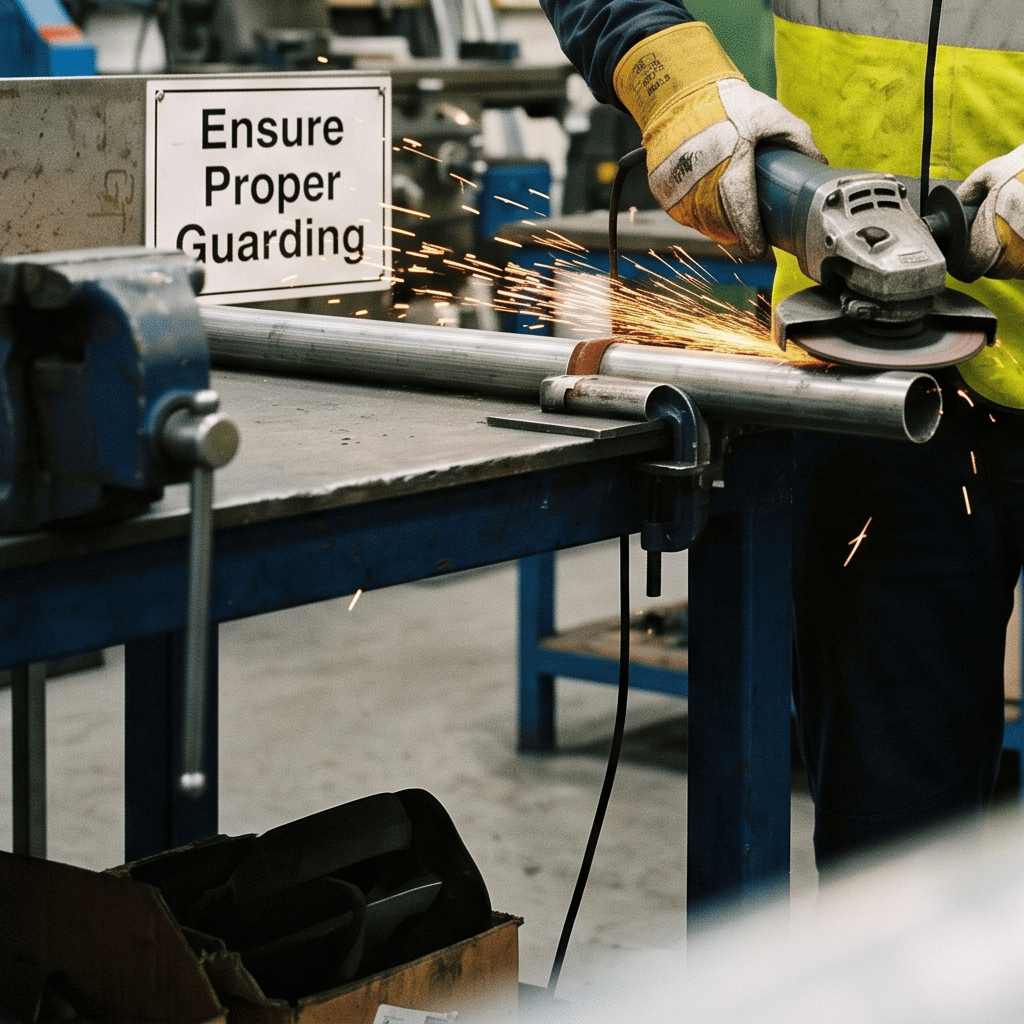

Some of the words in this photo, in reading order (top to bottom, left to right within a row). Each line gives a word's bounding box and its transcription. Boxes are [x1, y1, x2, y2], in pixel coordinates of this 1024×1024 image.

[201, 108, 344, 149] Ensure
[205, 166, 341, 214] Proper
[176, 218, 364, 264] Guarding
